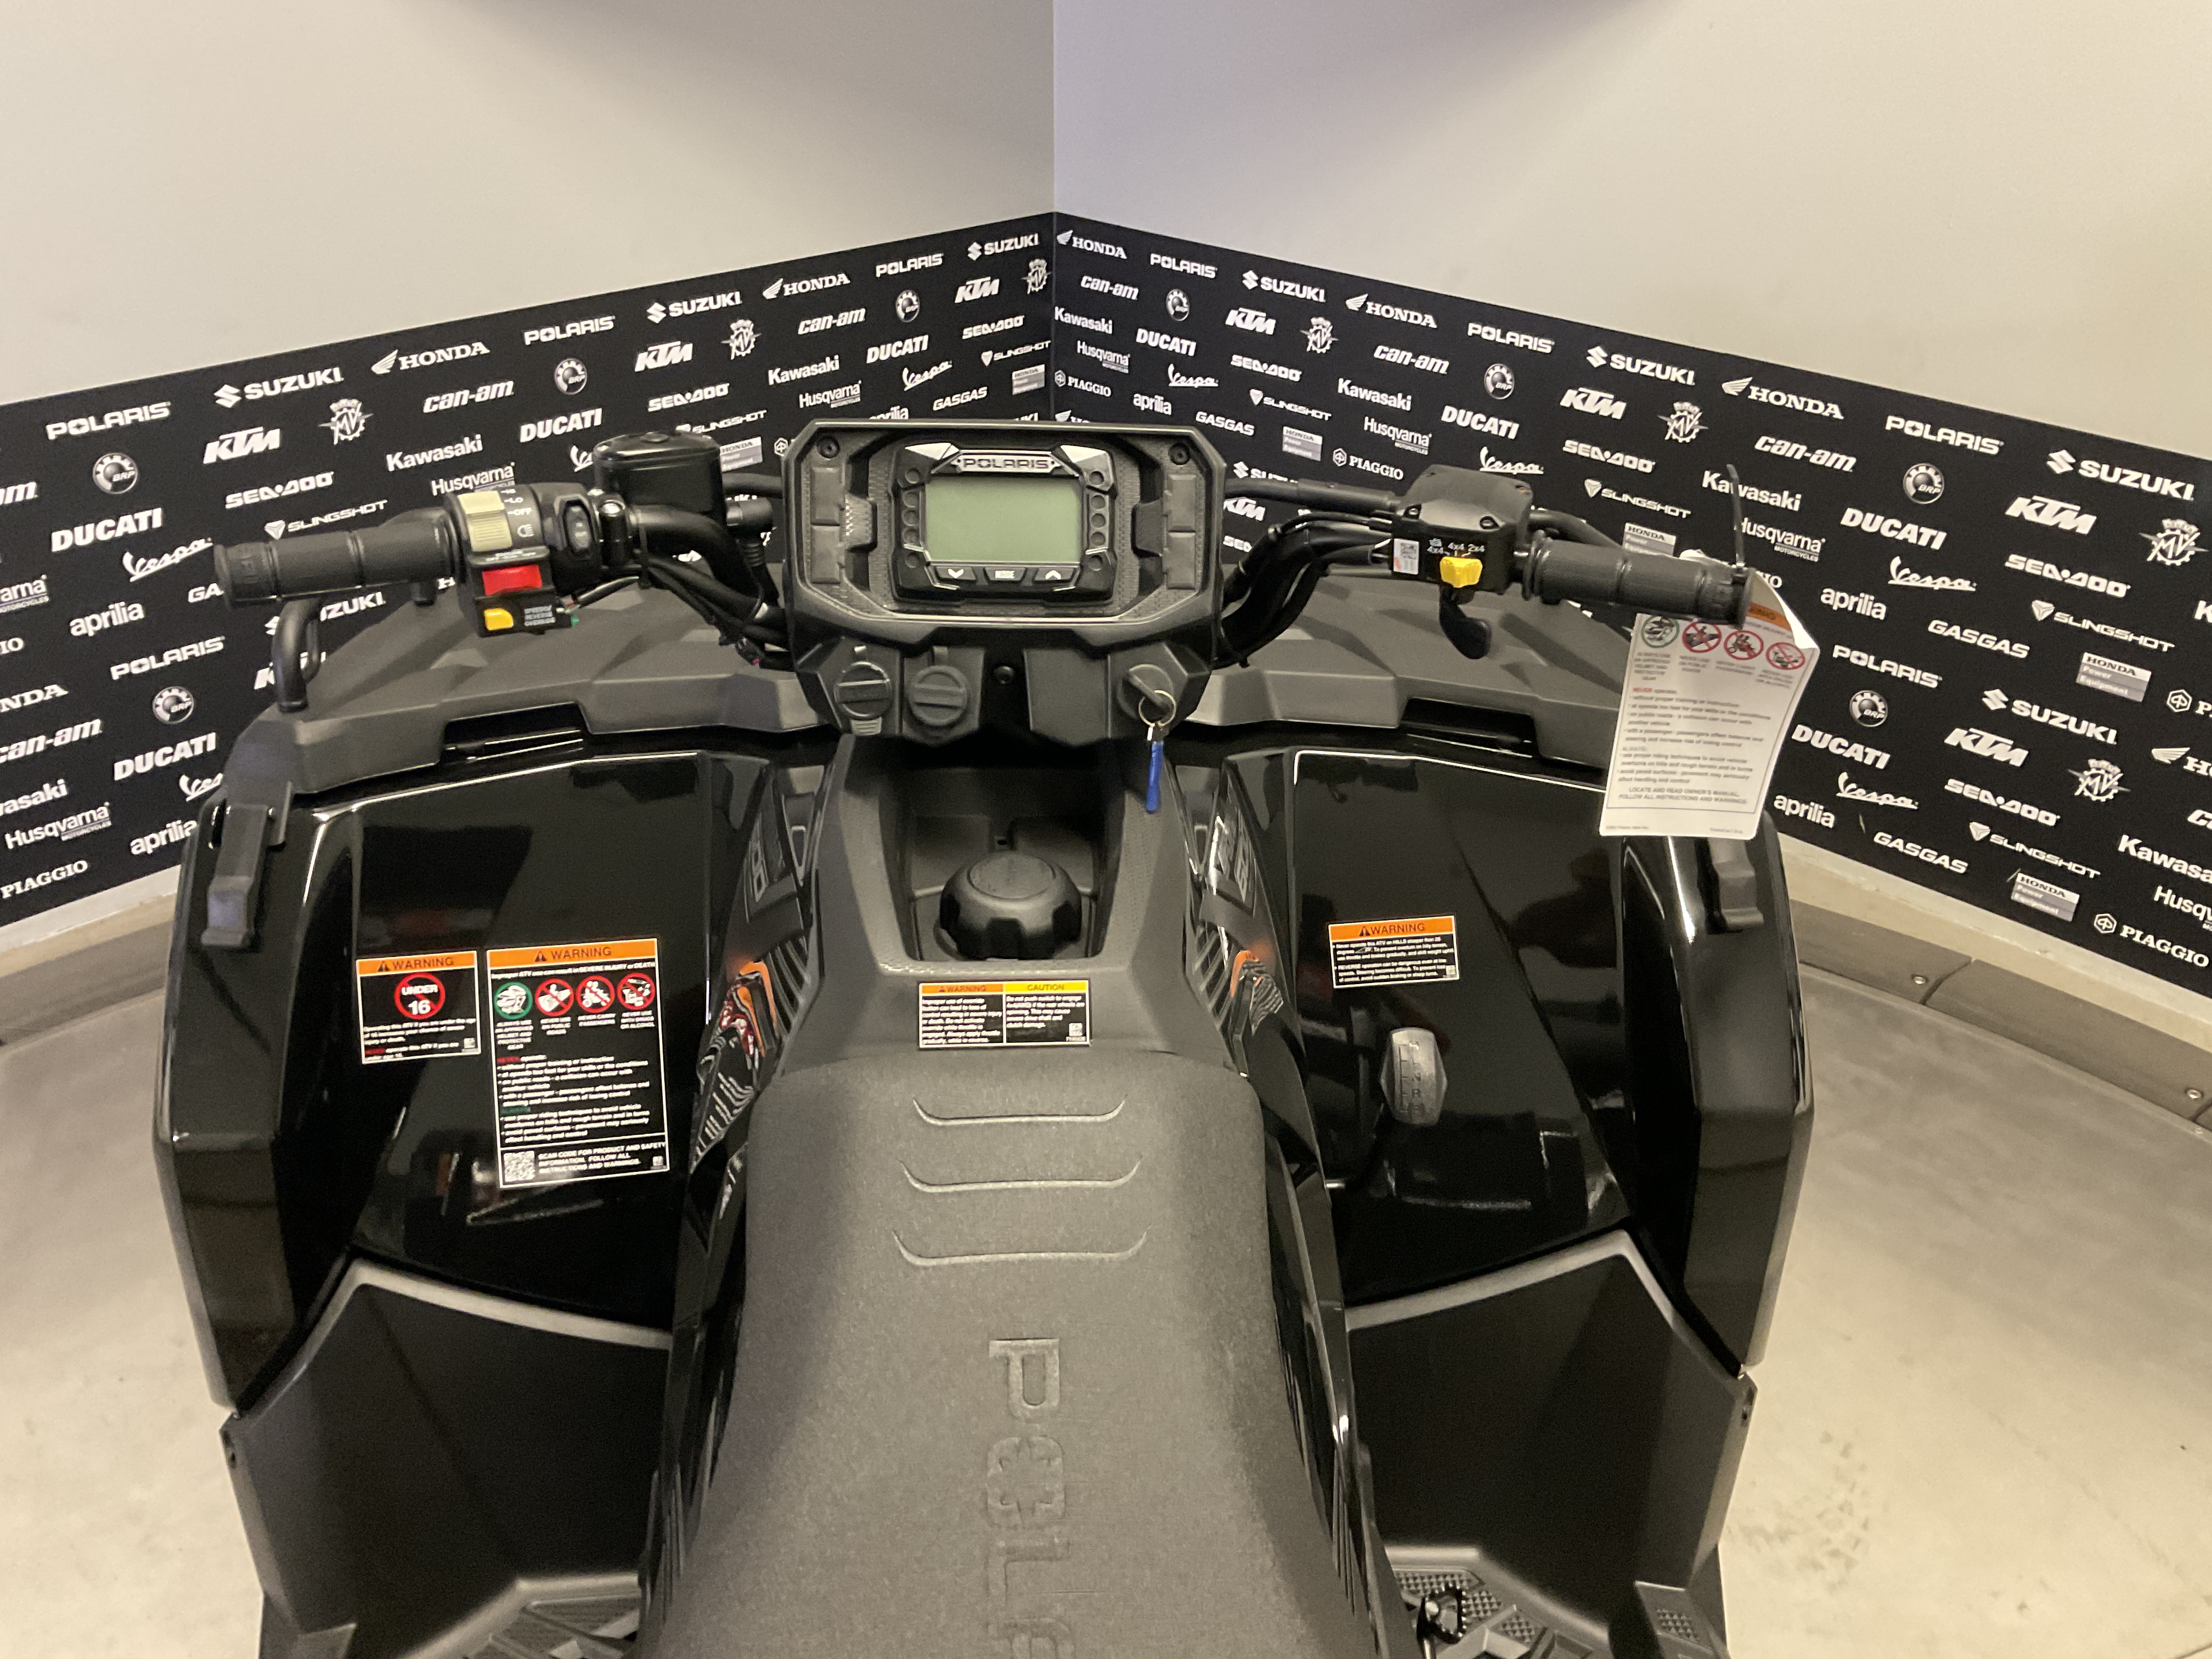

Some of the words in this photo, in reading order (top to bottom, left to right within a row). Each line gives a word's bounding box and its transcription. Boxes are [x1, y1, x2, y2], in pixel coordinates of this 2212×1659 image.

[984, 233, 1039, 255] SUZUKI
[1073, 236, 1127, 259] HONDA
[876, 253, 944, 277] POLARIS
[1150, 253, 1217, 278] POLARIS
[783, 273, 850, 296] HONDA
[955, 276, 1000, 303] KTM
[1081, 276, 1138, 300] can-am
[1261, 276, 1325, 302] SUZUKI
[669, 291, 742, 317] SUZUKI
[1366, 301, 1437, 328] HONDA
[524, 315, 616, 345] POLARIS
[798, 308, 866, 335] can-am
[1054, 306, 1112, 334] Kawasaki
[1226, 307, 1276, 335] KTM
[866, 335, 928, 363] DUCATI
[994, 340, 1051, 362] SLINGSHOT
[1077, 340, 1130, 366] Husqvarna
[1136, 328, 1196, 356] DUCATI
[1468, 323, 1555, 353] POLARIS
[398, 342, 490, 370] HONDA
[635, 341, 693, 371] KTM
[768, 355, 839, 385] Kawasaki
[1374, 346, 1449, 374] can-am
[1610, 354, 1695, 385] SUZUKI
[244, 367, 344, 399] SUZUKI
[568, 375, 585, 385] BRP
[902, 361, 952, 391] Vespa
[1068, 376, 1111, 397] PIAGGIO
[1168, 364, 1218, 388] Vespa
[1495, 382, 1513, 391] BRP
[423, 381, 514, 413] can-am
[799, 380, 861, 408] Husqvarna
[933, 387, 987, 411] GASGAS
[1133, 394, 1171, 415] aprilia
[1263, 397, 1331, 421] SLINGSHOT
[1338, 378, 1412, 411] Kawasaki
[1560, 387, 1627, 419] KTM
[1748, 386, 1844, 420] HONDA
[46, 402, 171, 441] POLARIS
[520, 408, 602, 443] DUCATI
[692, 410, 767, 433] SLINGSHOT
[1196, 411, 1254, 436] GASGAS
[1364, 416, 1432, 447] Husqvarna
[1441, 405, 1519, 439] DUCATI
[1885, 415, 2004, 454] POLARIS
[203, 426, 281, 464] KTM
[386, 434, 483, 472] Kawasaki
[1754, 436, 1857, 472] can-am
[963, 459, 1048, 469] POLARIS
[1349, 455, 1403, 479] PIAGGIO
[1480, 447, 1543, 475] Vespa
[112, 471, 134, 482] BRP
[432, 462, 515, 495] Husqvarna
[1917, 483, 1941, 494] BRP
[2079, 460, 2194, 501] SUZUKI
[287, 500, 387, 532] SLINGSHOT
[1223, 497, 1265, 521] KTM
[1601, 488, 1691, 518] SLINGSHOT
[2005, 495, 2097, 535] KTM
[52, 507, 163, 552] DUCATI
[1627, 526, 1664, 541] HONDA
[1841, 507, 1946, 550] DUCATI
[122, 537, 213, 583] Vespa
[1888, 556, 1977, 591] Vespa
[70, 601, 145, 636] aprilia
[320, 592, 386, 622] ZUKI
[1821, 588, 1886, 620] aprilia
[1928, 620, 2030, 658] GASGAS
[2053, 611, 2175, 652] SLINGSHOT
[110, 636, 225, 680] POLARIS
[1833, 645, 1942, 688] POLARIS
[2086, 656, 2136, 676] HONDA
[0, 684, 69, 713] NDA
[1864, 709, 1884, 719] BRP
[2012, 700, 2117, 744] SUZUKI
[114, 732, 216, 781] DUCATI
[1792, 725, 1890, 769] DUCATI
[1944, 727, 2029, 766] KTM
[0, 779, 68, 816] asaki
[1836, 772, 1918, 809] Vespa
[5, 802, 109, 849] Husqvarna
[1774, 795, 1835, 828] aprilia
[1874, 832, 1968, 873] GASGAS
[1989, 834, 2101, 879] SLINGSHOT
[2118, 835, 2212, 884] Kawasa
[0, 860, 88, 899] PIAGGIO
[2019, 876, 2066, 898] HONDA
[1370, 923, 1425, 934] WARNING
[551, 946, 612, 960] WARNING
[2120, 925, 2209, 967] PIAGGIO
[392, 957, 454, 970] WARNING
[402, 984, 438, 996] UNDER
[408, 1000, 431, 1015] 16
